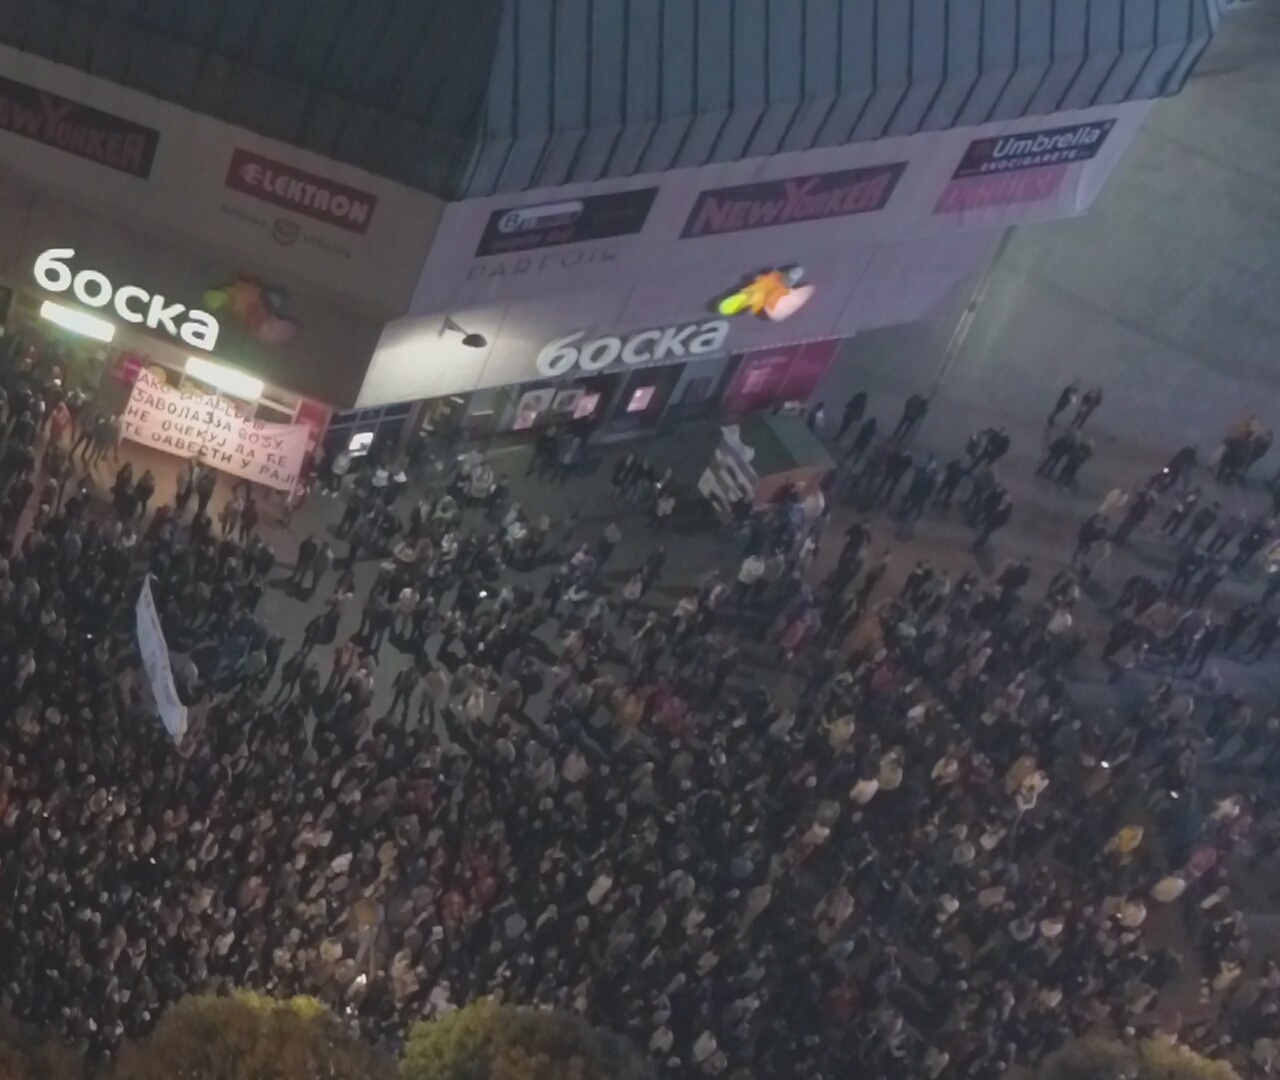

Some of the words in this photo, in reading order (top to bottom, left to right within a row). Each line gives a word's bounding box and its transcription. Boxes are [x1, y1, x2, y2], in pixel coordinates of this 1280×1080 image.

[993, 127, 1102, 158] Umbrella
[34, 248, 219, 351] боска
[536, 320, 729, 376] боска
[127, 406, 149, 423] НЕ
